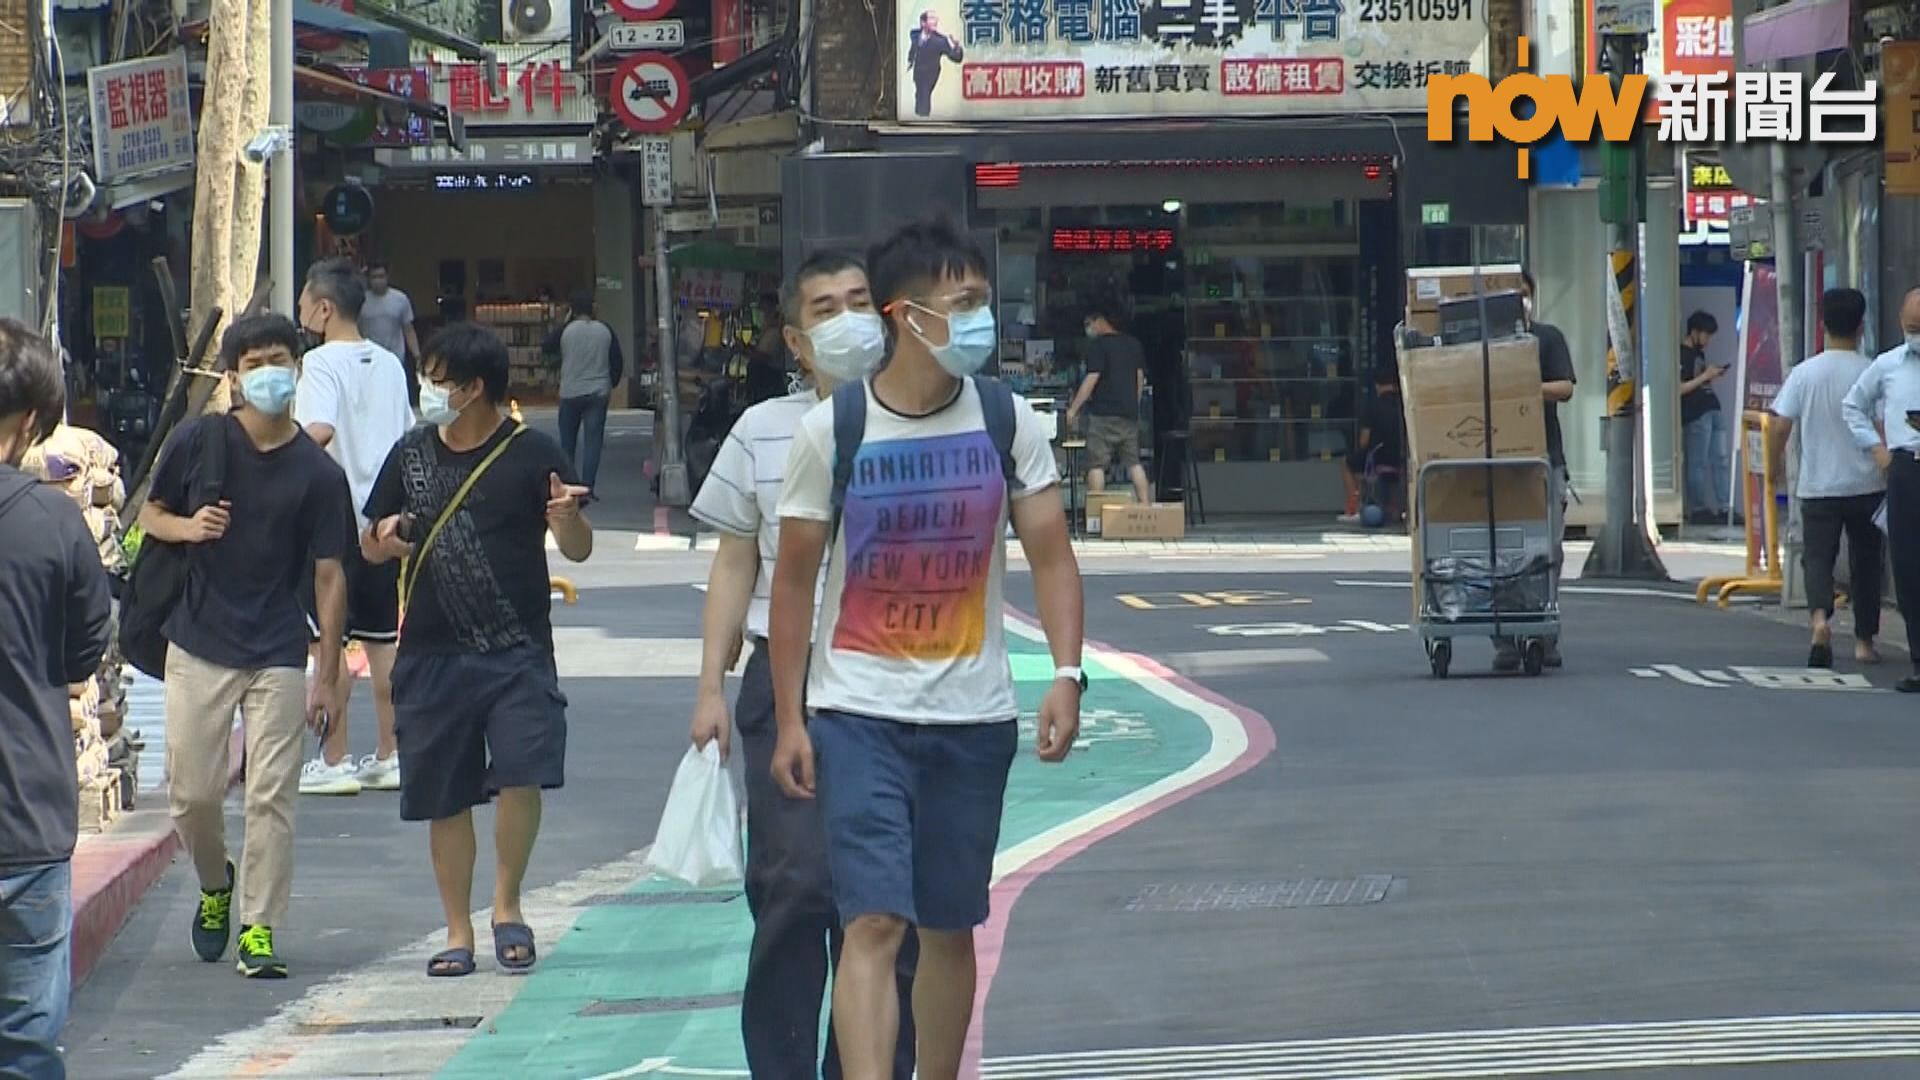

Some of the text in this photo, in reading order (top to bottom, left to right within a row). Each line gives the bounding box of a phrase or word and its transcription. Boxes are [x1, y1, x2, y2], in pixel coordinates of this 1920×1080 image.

[1360, 0, 1472, 21] 23510591
[965, 66, 1083, 97] 高價收購
[1095, 64, 1210, 95] 新舊買賣
[107, 69, 168, 129] 監視器
[877, 500, 967, 532] BEACH
[919, 549, 985, 581] YORK
[886, 601, 943, 631] CITY
